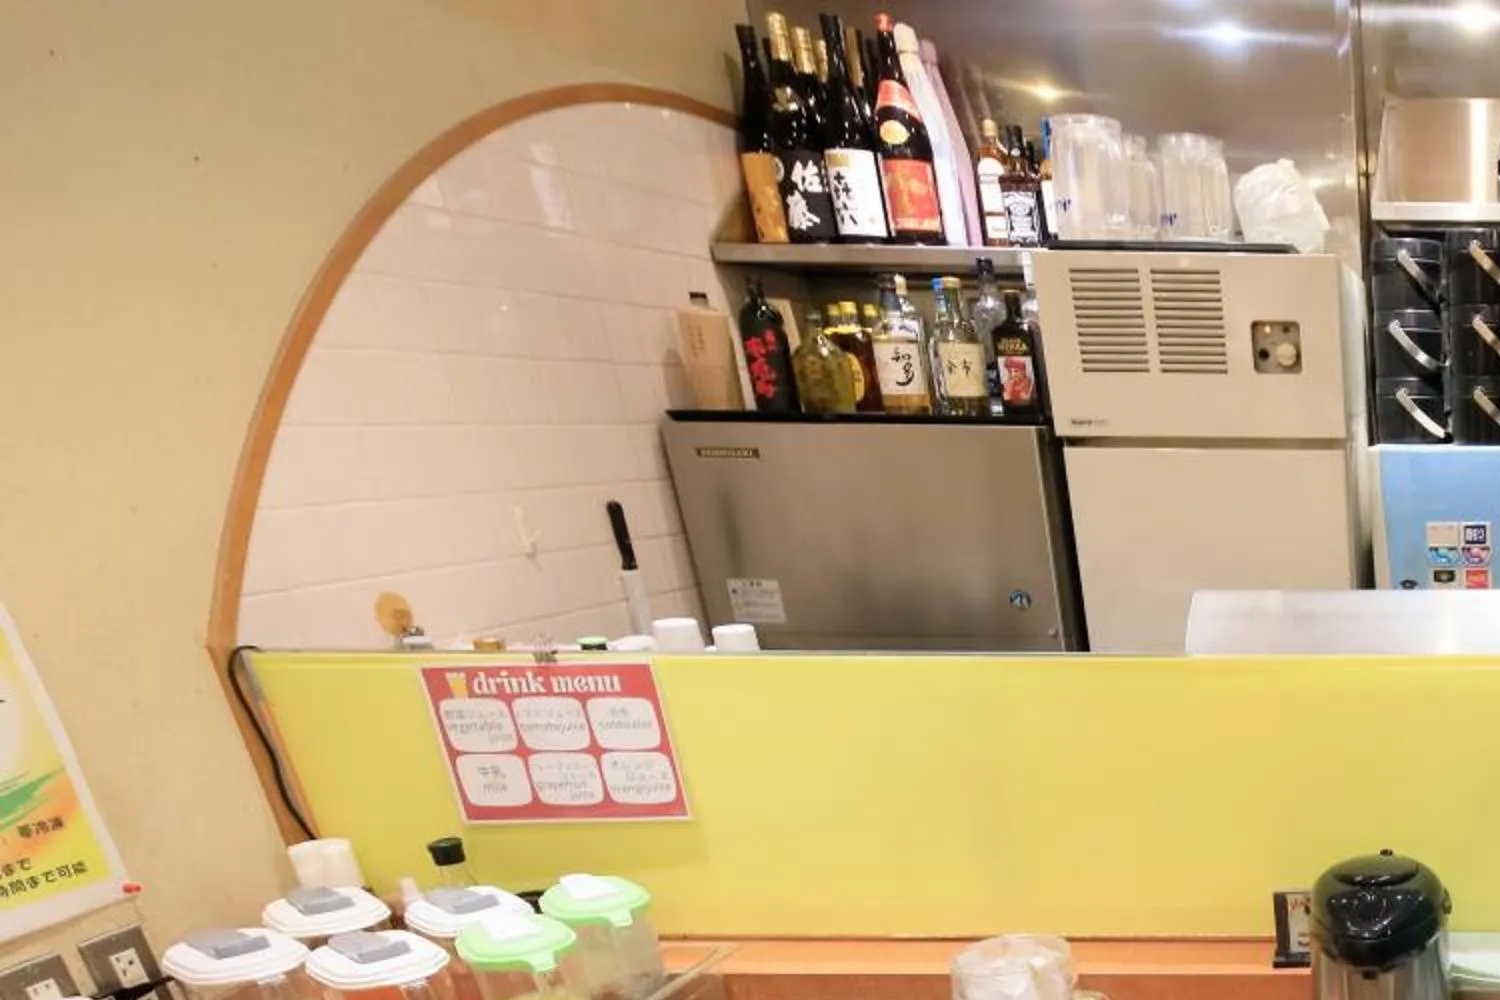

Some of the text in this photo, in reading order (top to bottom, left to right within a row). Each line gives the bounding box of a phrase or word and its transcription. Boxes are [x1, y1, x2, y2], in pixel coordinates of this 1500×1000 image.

[473, 671, 622, 695] drink menu
[0, 857, 32, 880] まで
